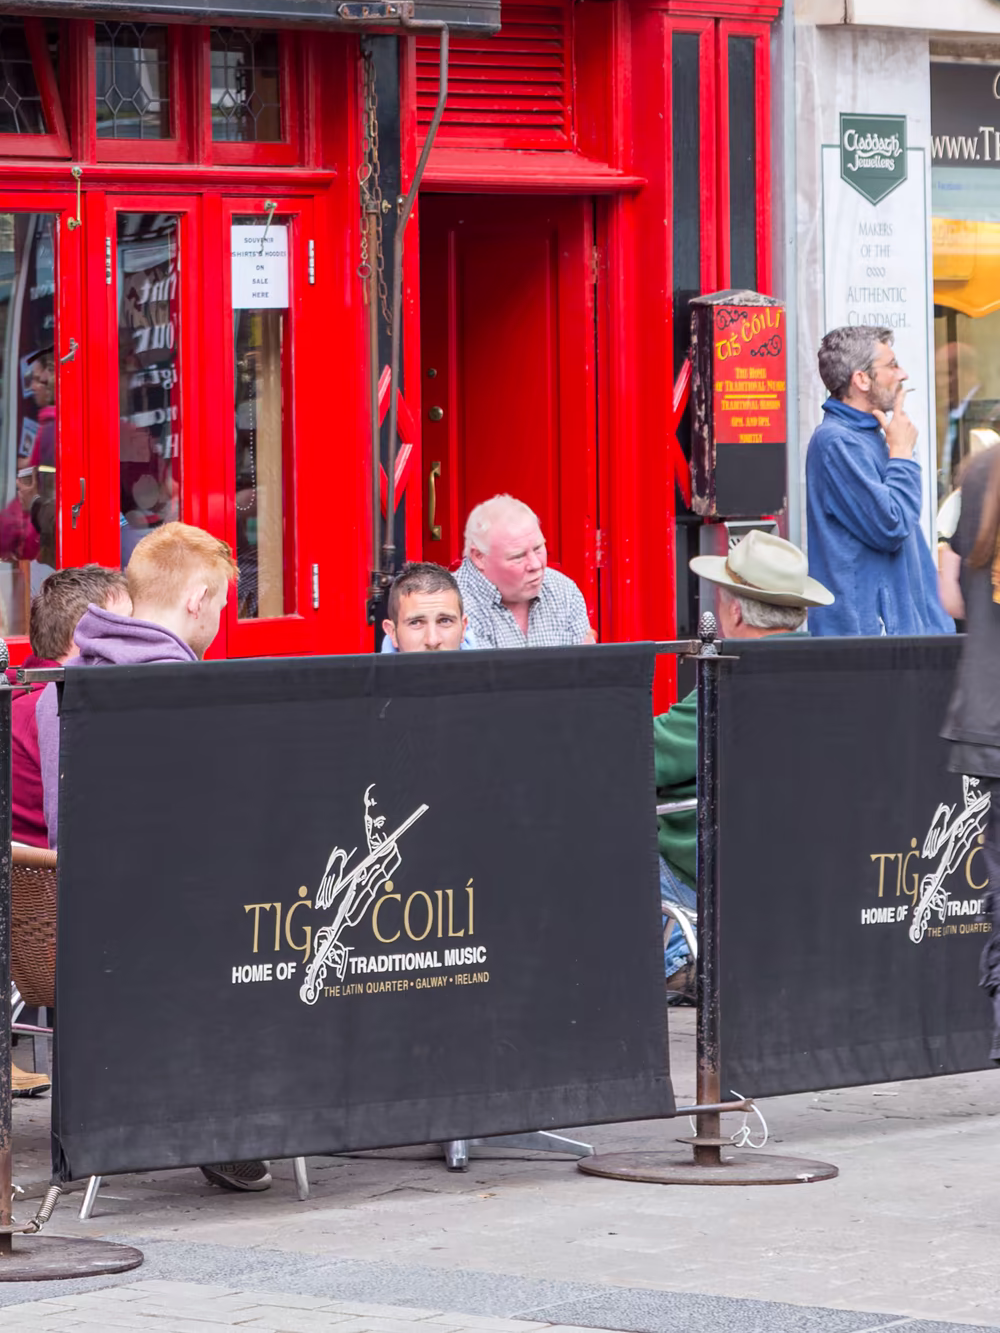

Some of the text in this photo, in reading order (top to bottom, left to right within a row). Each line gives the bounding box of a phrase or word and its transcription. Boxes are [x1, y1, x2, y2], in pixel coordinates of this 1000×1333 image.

[847, 153, 896, 172] Jewellers
[859, 221, 893, 237] MAKERS
[847, 286, 907, 303] AUTHENTIC
[861, 907, 895, 925] HOME
[897, 906, 909, 922] OF
[927, 926, 942, 938] THE
[232, 946, 487, 984] HOME OF TRADITIONAL MUSIC
[324, 972, 489, 998] THE LATIN QUARTER GALWAY IRELAND
